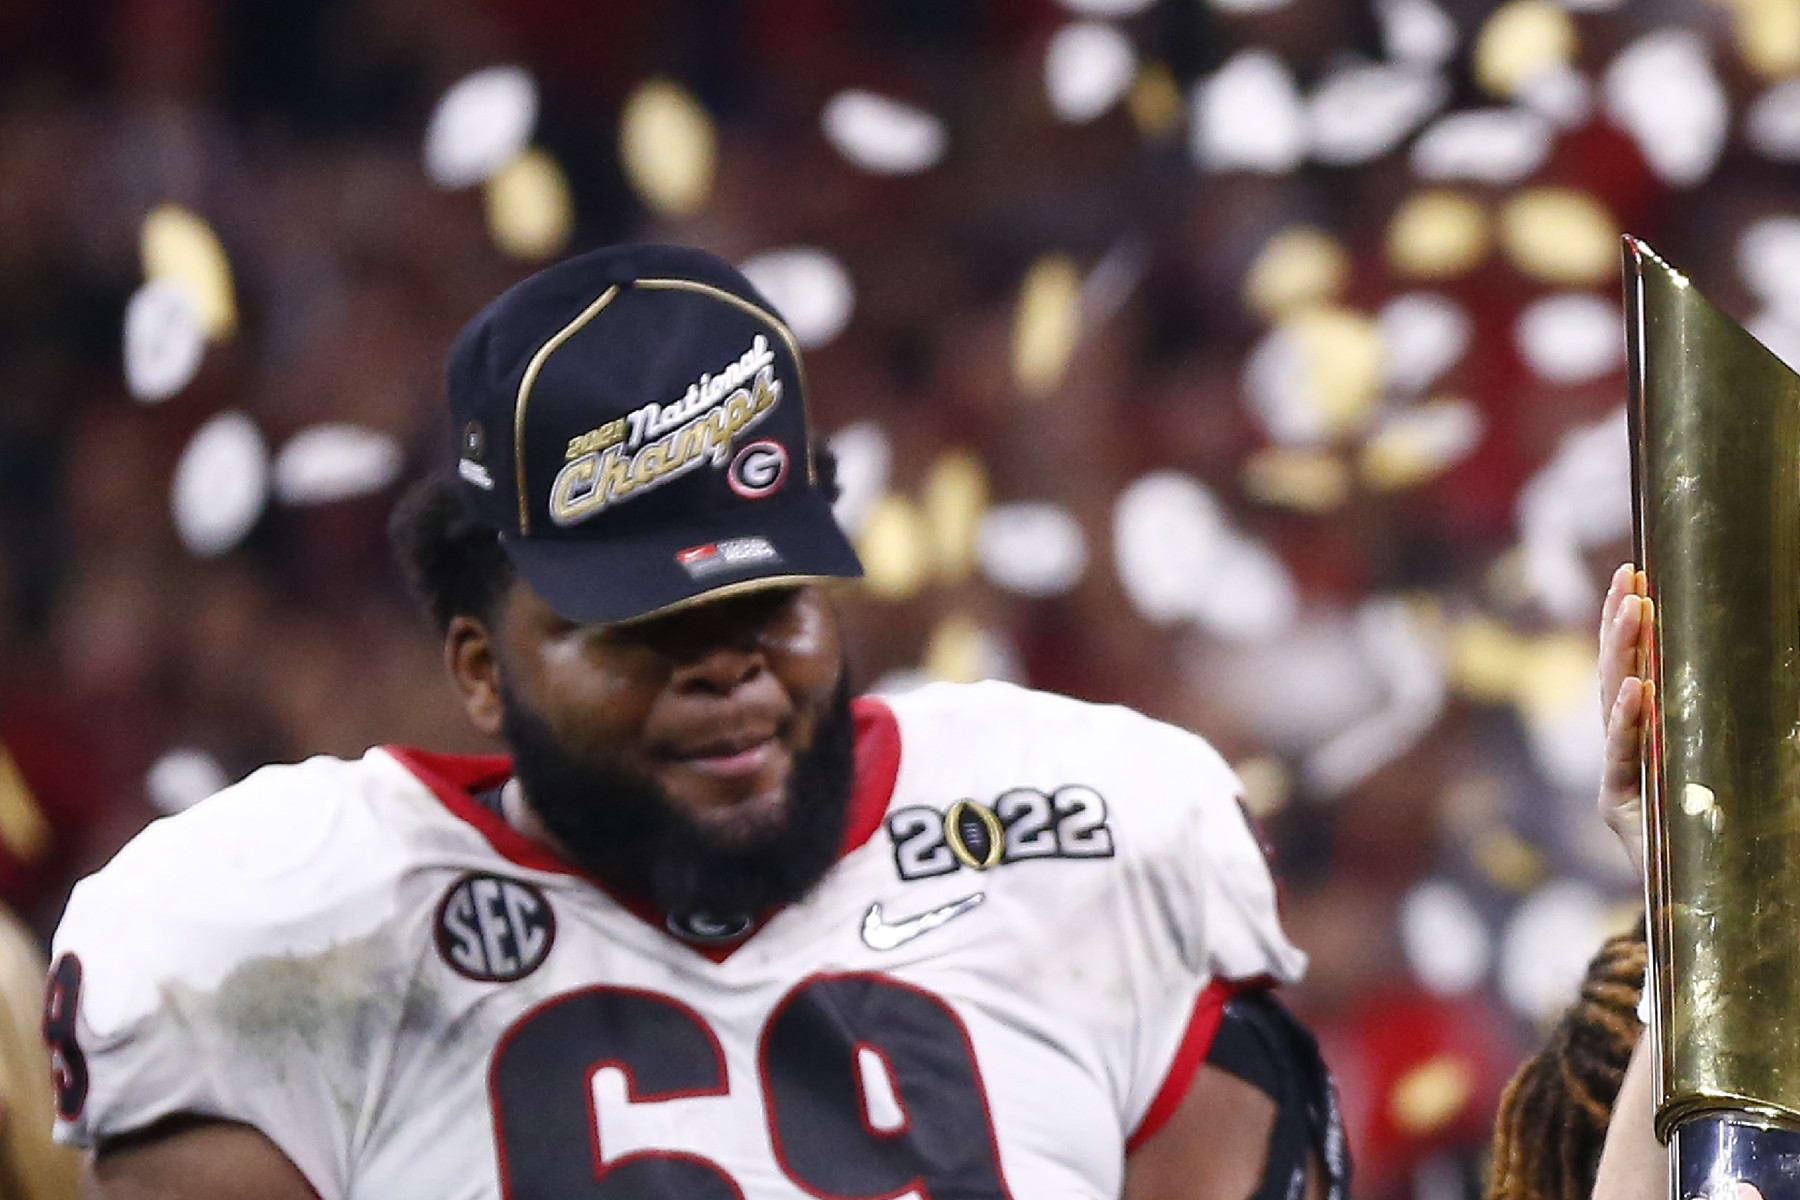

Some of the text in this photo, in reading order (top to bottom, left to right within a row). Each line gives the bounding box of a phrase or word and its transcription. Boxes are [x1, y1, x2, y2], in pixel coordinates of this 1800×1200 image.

[625, 334, 776, 449] National
[550, 364, 783, 527] Champs
[732, 441, 785, 496] G
[889, 783, 1115, 881] 2022
[442, 874, 544, 980] SEC
